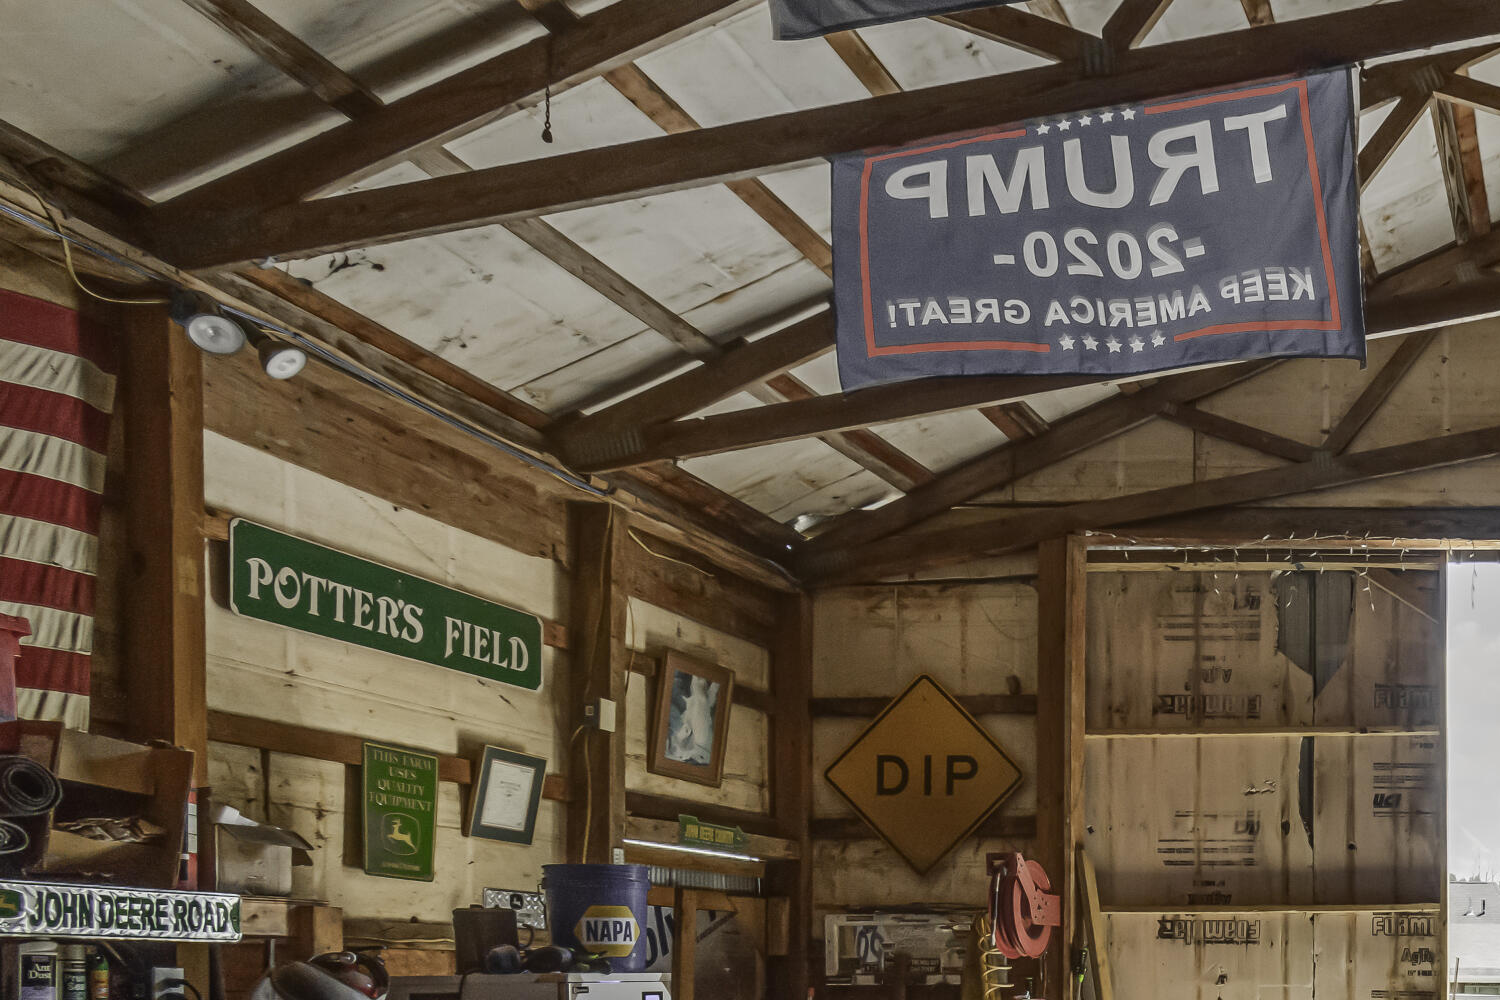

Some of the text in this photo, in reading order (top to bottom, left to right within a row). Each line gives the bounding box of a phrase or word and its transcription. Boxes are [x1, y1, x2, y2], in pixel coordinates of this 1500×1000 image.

[247, 557, 531, 675] POTTER'S FIELD
[403, 754, 432, 770] FARM
[388, 766, 417, 780] USES
[875, 754, 979, 797] DIP
[377, 779, 425, 797] QUALITY
[368, 791, 433, 812] EQUIPMENT
[28, 890, 230, 934] JOHN DEERE ROAD
[585, 919, 633, 943] NAPA
[28, 970, 52, 979] Dust
[33, 963, 51, 972] Ant
